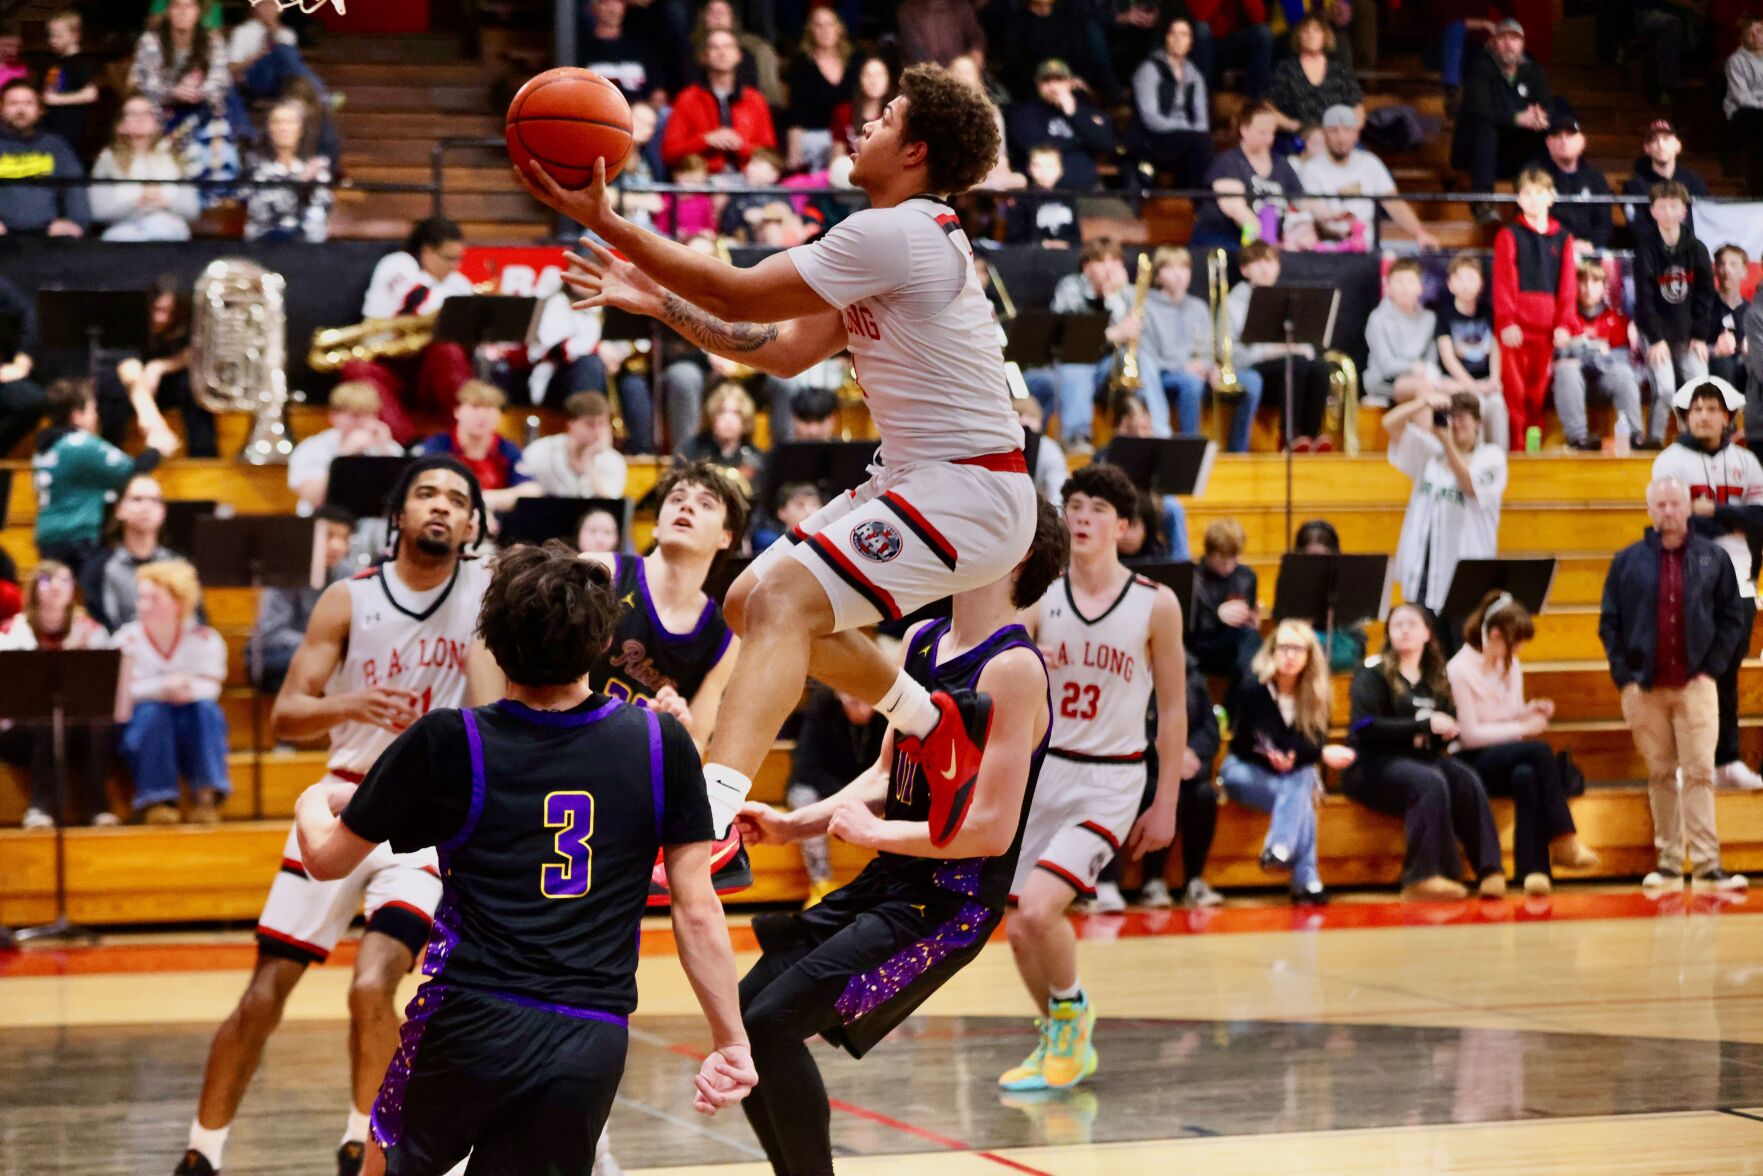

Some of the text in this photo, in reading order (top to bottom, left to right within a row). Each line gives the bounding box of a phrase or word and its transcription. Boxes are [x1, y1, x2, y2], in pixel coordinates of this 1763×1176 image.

[1083, 641, 1135, 684] LONG
[1060, 681, 1101, 721] 23
[540, 790, 595, 899] 3
